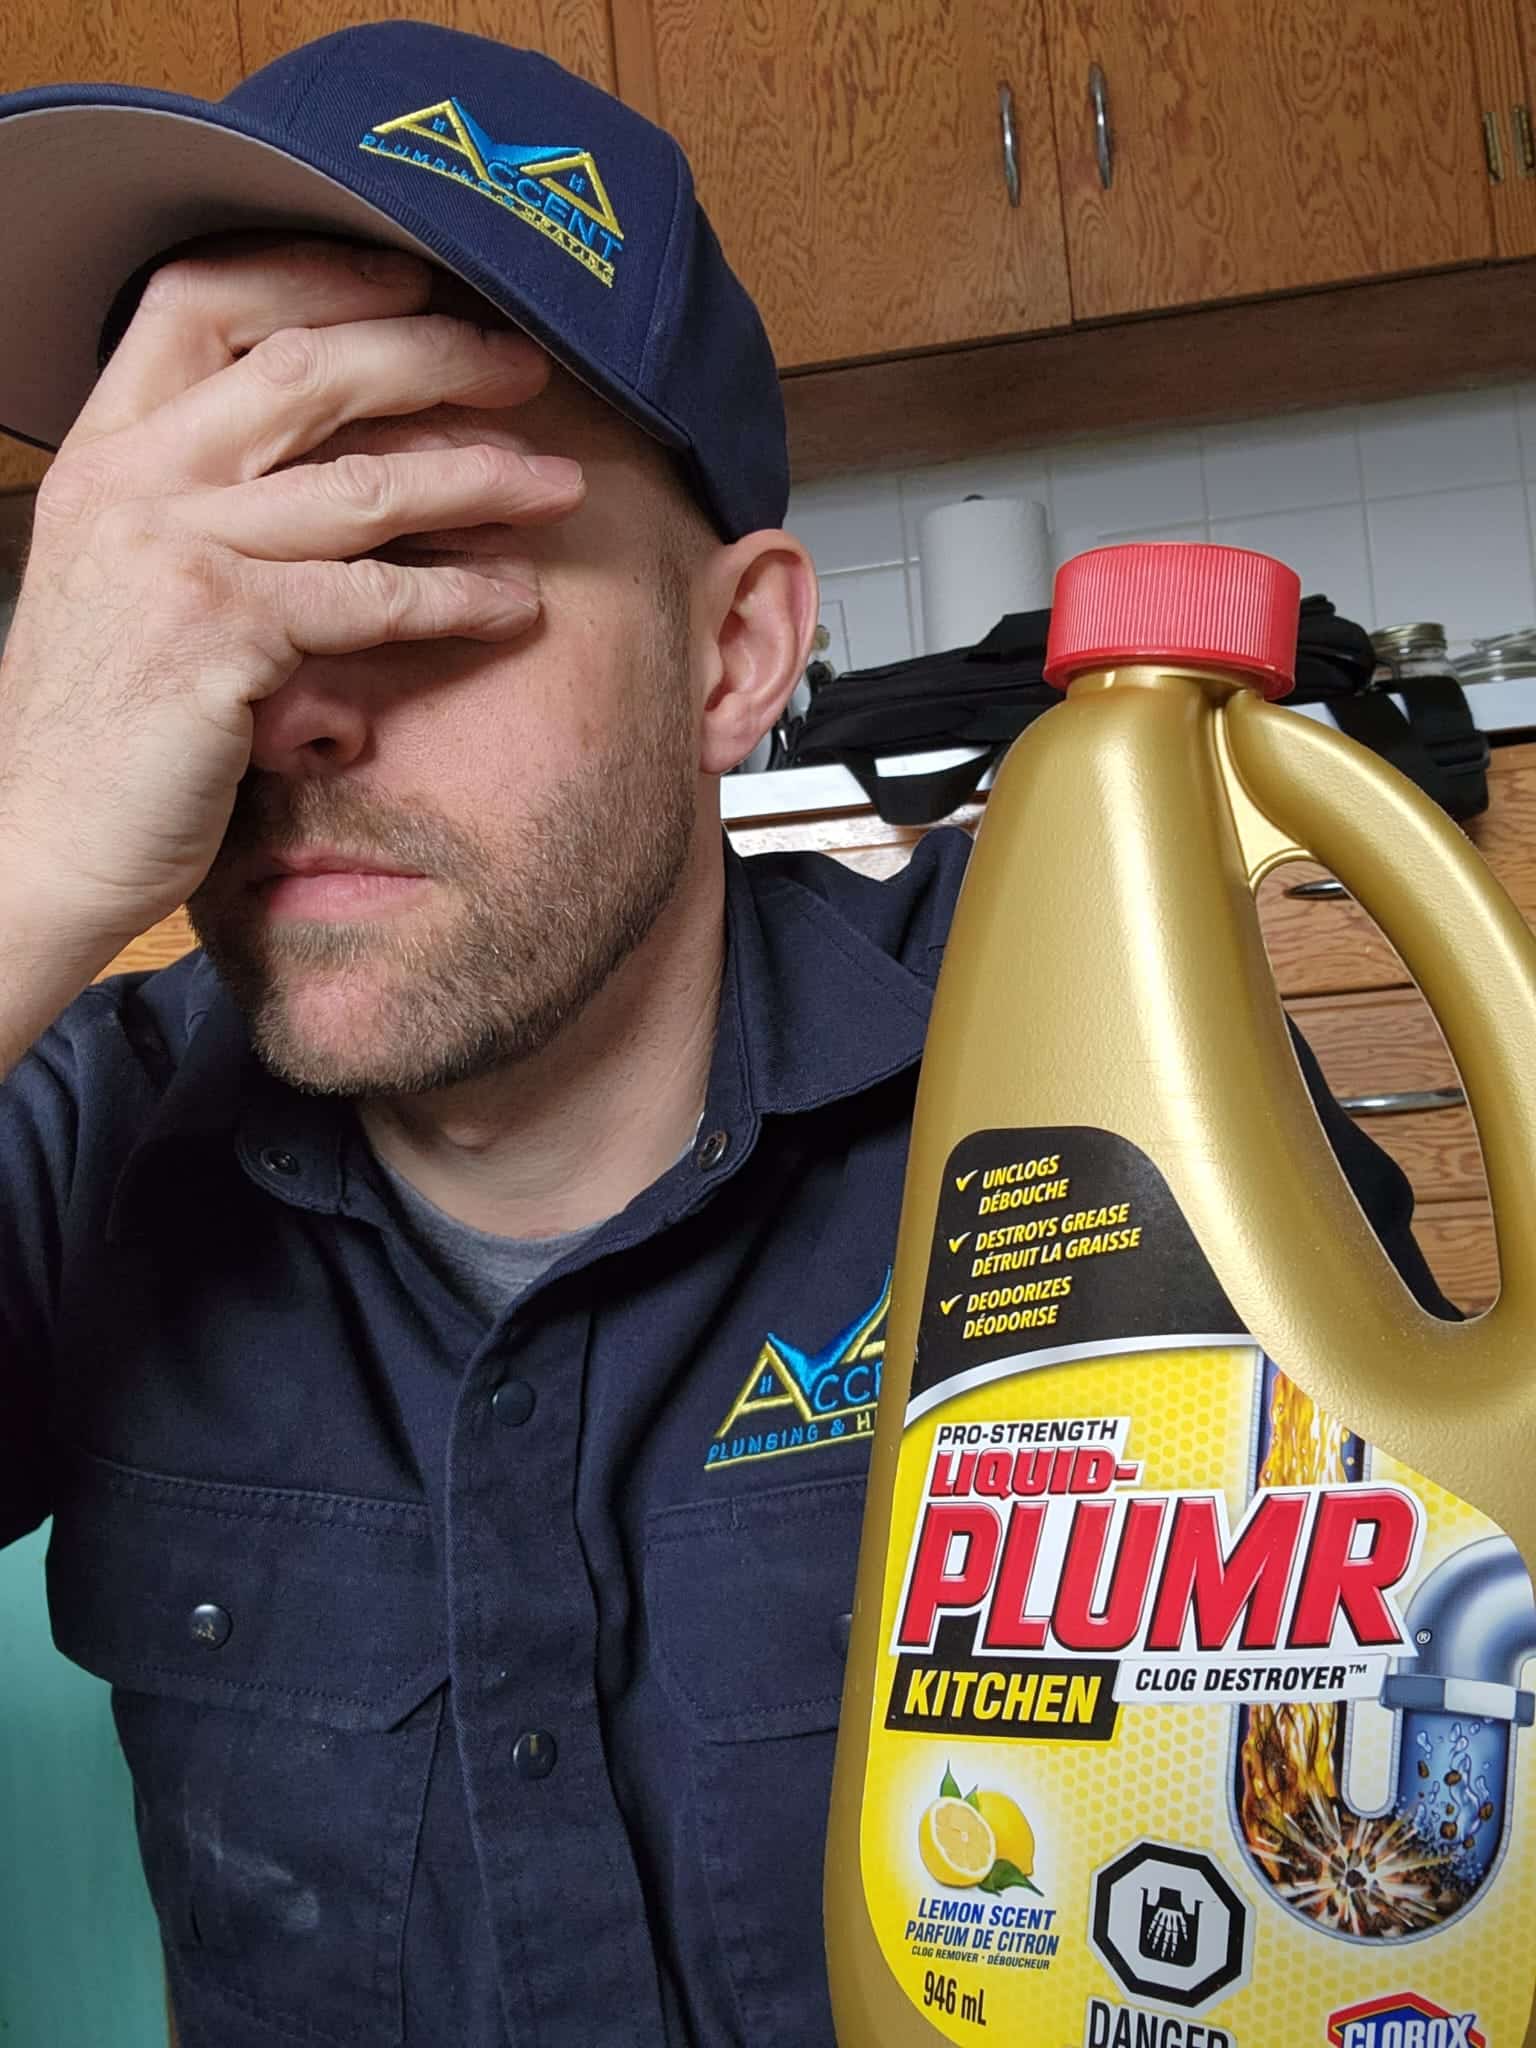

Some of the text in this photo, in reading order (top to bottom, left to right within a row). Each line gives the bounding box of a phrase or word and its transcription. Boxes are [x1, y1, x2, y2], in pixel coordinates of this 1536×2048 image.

[982, 1154, 1061, 1190] UNCLOGS
[977, 1178, 1070, 1216] DÉBOUCHE
[974, 1202, 1131, 1252] DESTROYS GREASE
[970, 1227, 1142, 1278] DÉTRUIT LA GRAISSE
[966, 1275, 1073, 1313] DEODORIZES
[962, 1304, 1059, 1341] DÉODORISE
[829, 1418, 846, 1436] &
[937, 1419, 1119, 1446] PRO-STRENGTH
[929, 1446, 1140, 1501] LIQUID-
[904, 1665, 1102, 1724] KITCHEN
[1135, 1667, 1197, 1692] CLOG
[917, 1897, 1057, 1931] LEMON SCENT
[904, 1920, 1060, 1957] PARFUM DE CITRON
[911, 1945, 1050, 1971] CLOG REMOVER DÉBOUCHEUR
[923, 1970, 987, 2027] 946 mL
